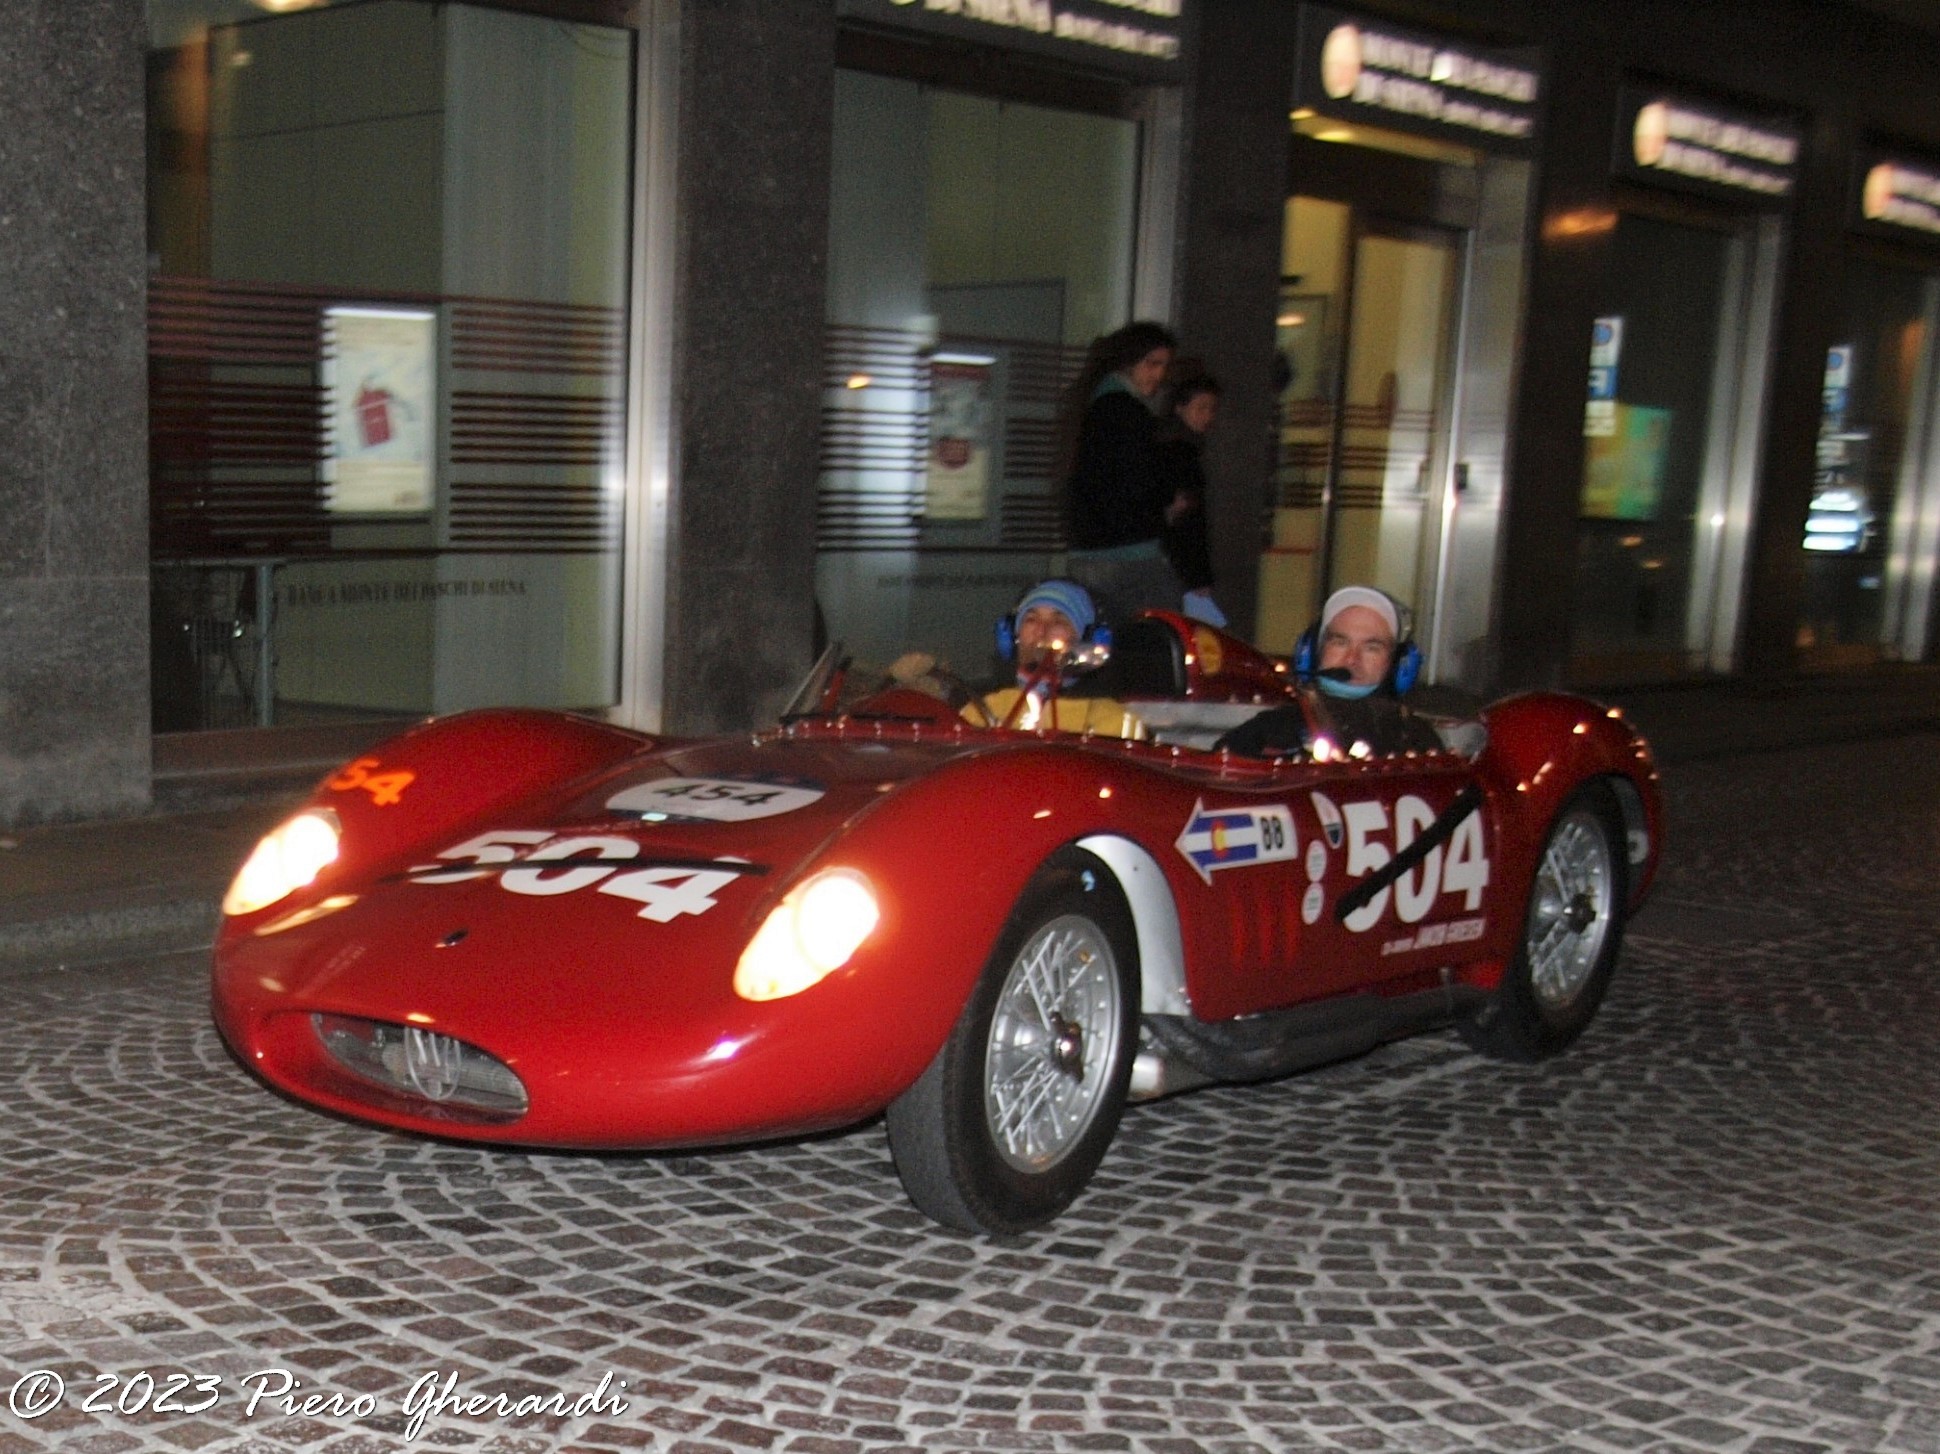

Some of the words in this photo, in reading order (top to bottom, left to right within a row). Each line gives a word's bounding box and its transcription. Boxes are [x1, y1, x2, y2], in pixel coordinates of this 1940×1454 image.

[652, 784, 785, 806] 454
[408, 830, 752, 923] 504
[1342, 795, 1490, 933] 504
